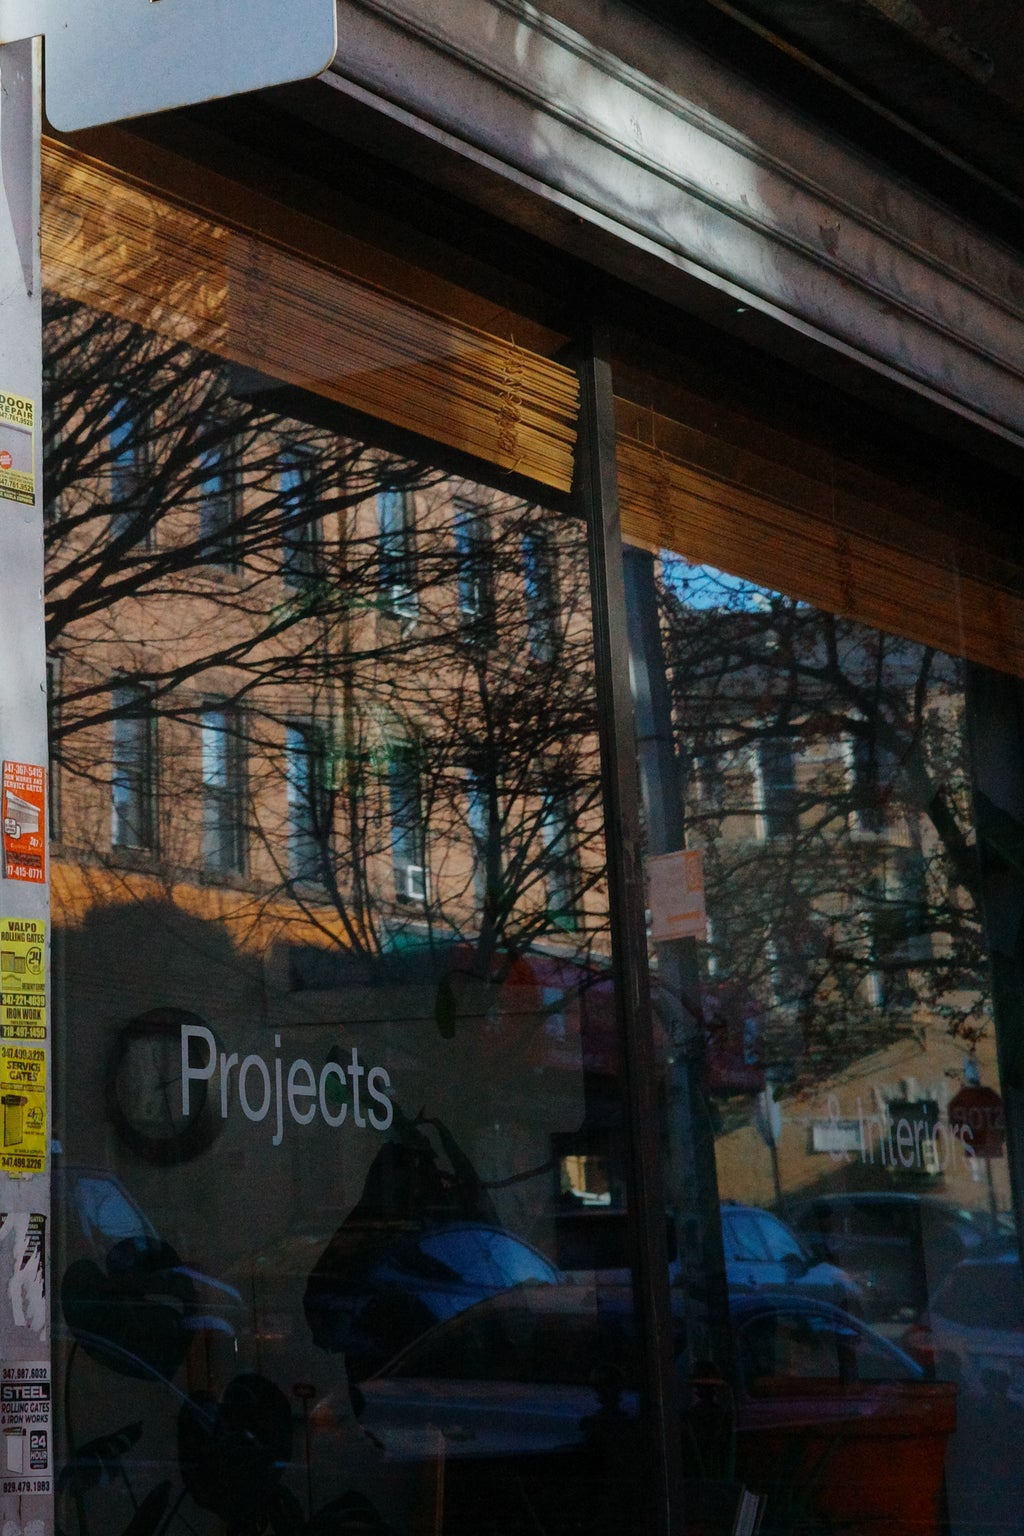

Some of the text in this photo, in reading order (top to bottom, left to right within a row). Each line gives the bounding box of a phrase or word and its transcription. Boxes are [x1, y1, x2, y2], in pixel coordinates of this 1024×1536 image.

[8, 921, 37, 933] VALPO
[1, 931, 45, 944] ROLLING GATES
[28, 951, 42, 966] 24
[6, 1007, 42, 1020] IRON WORK
[6, 1061, 41, 1072] SERVICE
[9, 1070, 38, 1081] GATES
[180, 1024, 394, 1146] Projects
[857, 1097, 978, 1175] Interiors
[3, 1385, 48, 1400] STEEL
[1, 1402, 50, 1413] ROLLING GATES
[7, 1415, 24, 1424] IRON
[25, 1414, 49, 1424] WORKS
[30, 1435, 47, 1449] 24
[31, 1450, 48, 1460] HOUR
